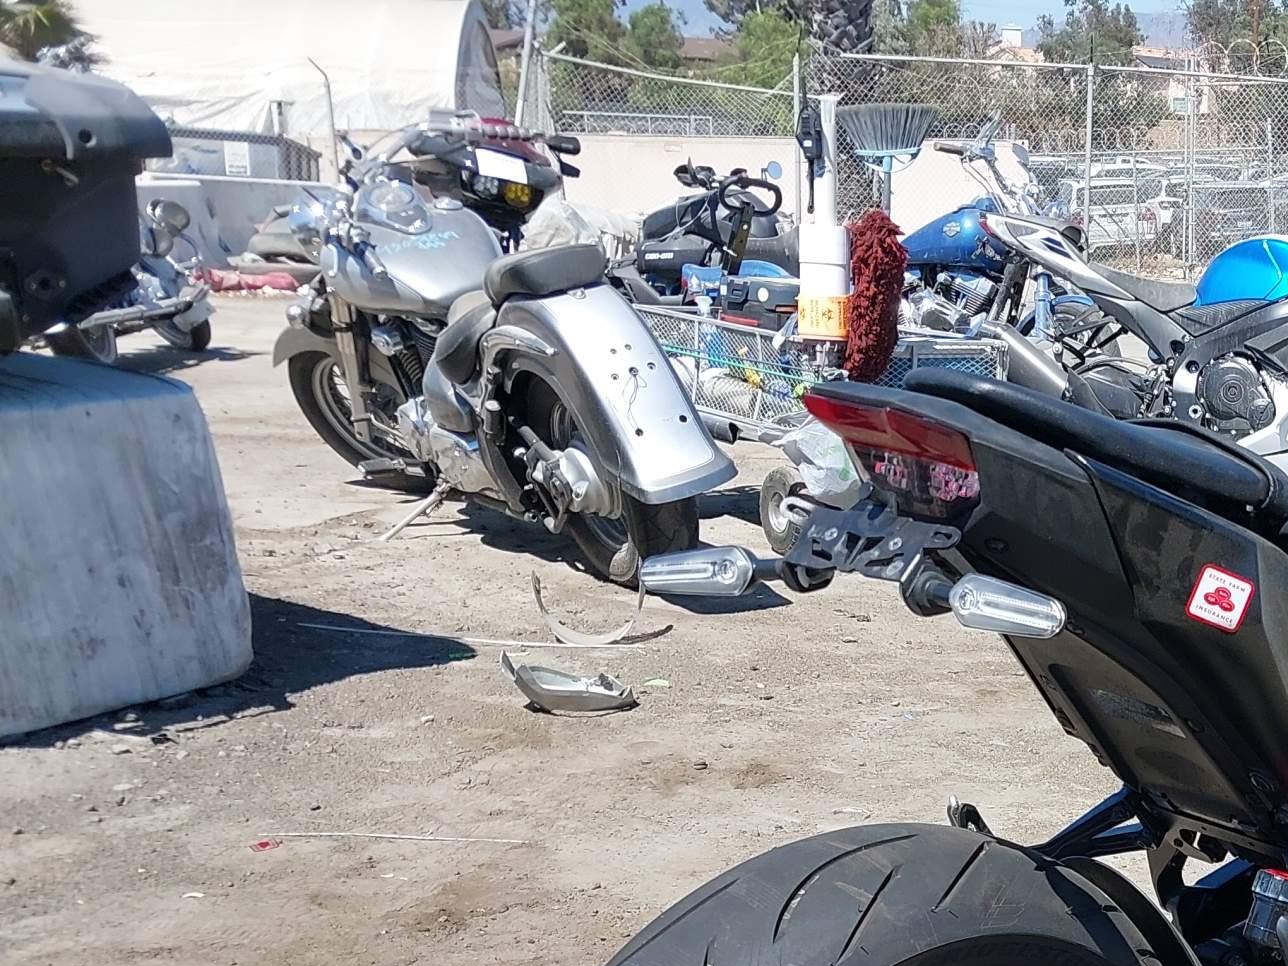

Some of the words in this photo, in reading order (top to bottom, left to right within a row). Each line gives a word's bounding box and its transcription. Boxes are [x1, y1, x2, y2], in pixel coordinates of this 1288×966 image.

[1208, 573, 1227, 585] STATE
[1229, 582, 1246, 593] FARM
[1195, 604, 1233, 624] INSURANCE
